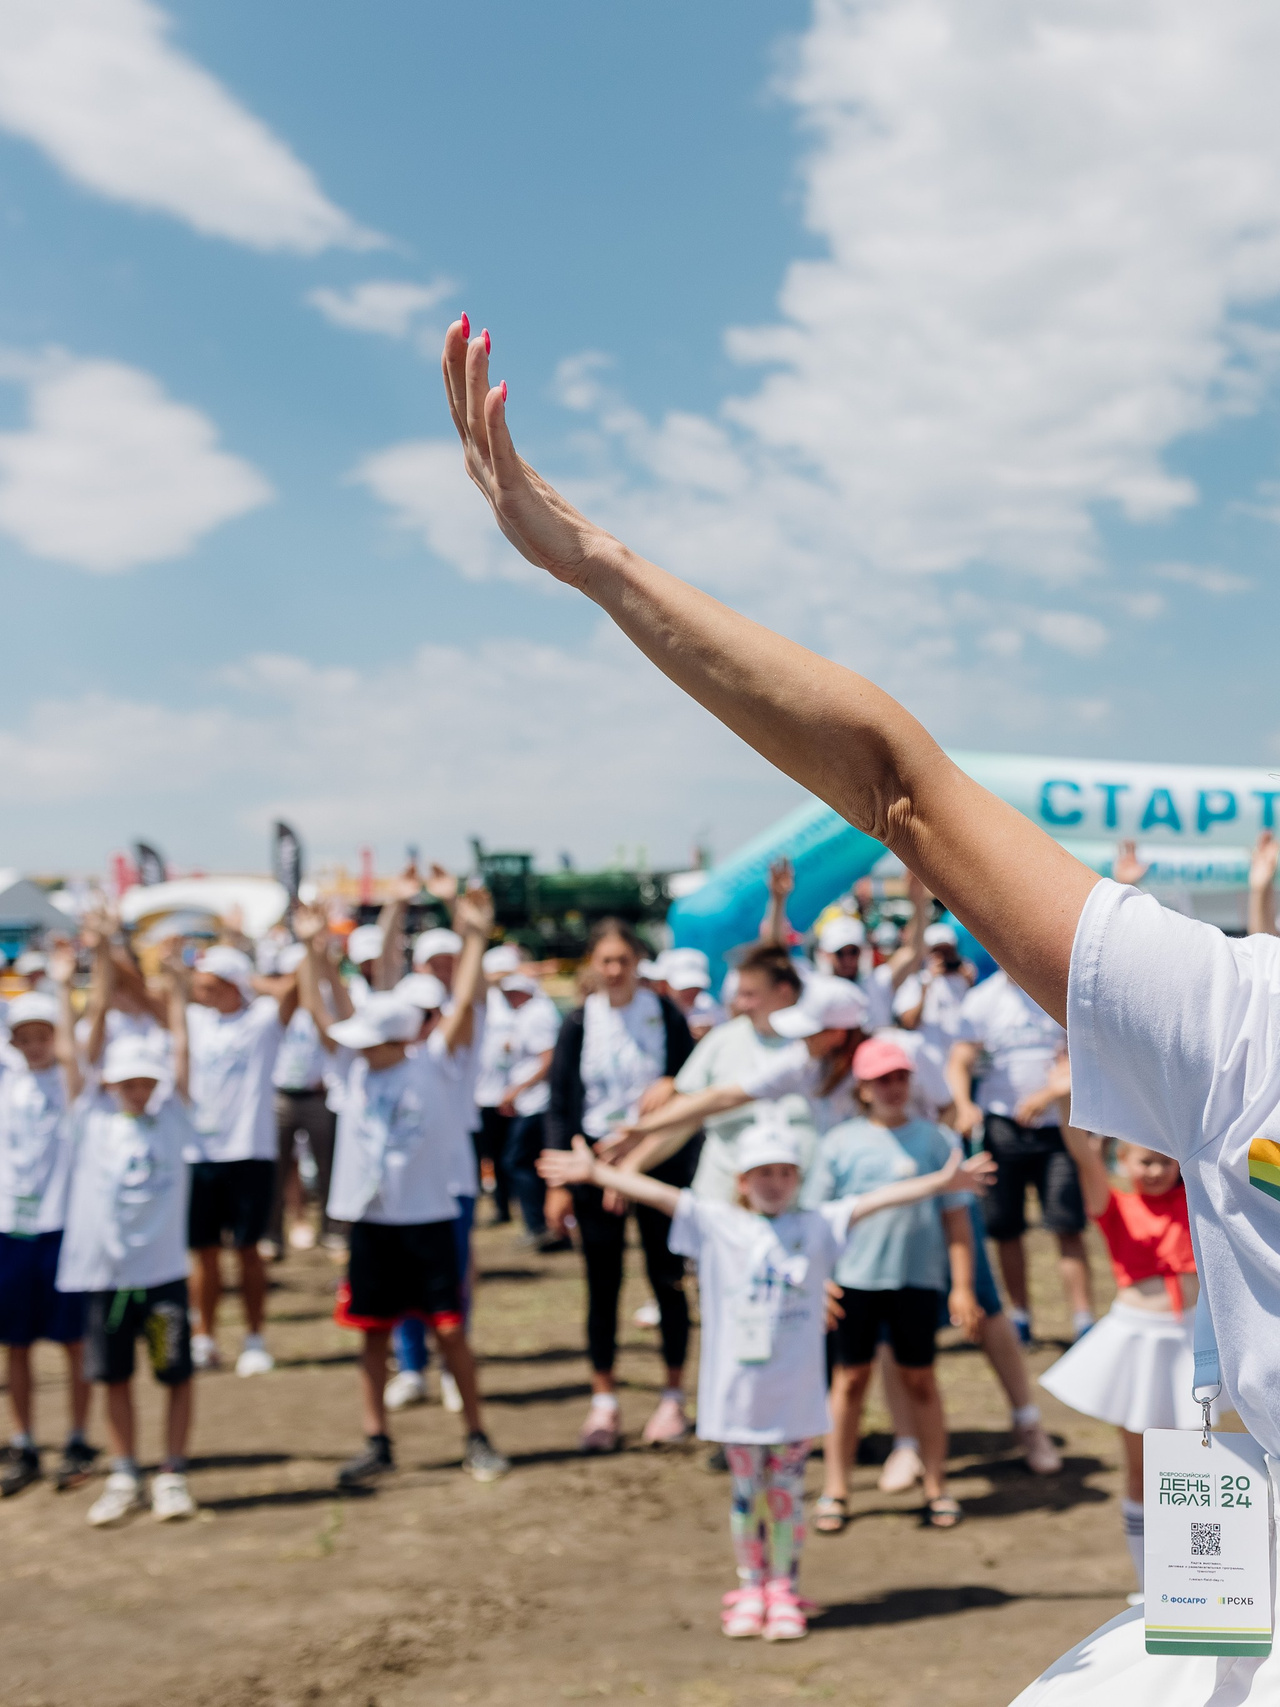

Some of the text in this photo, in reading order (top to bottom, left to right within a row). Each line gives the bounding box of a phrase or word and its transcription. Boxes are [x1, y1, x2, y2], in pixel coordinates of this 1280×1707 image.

[1160, 1478, 1210, 1492] ДЕНЬ
[1221, 1475, 1251, 1491] 20
[1159, 1492, 1210, 1507] ПОЛЯ
[1221, 1492, 1252, 1508] 24
[1170, 1596, 1206, 1605] ФОСАГРО
[1227, 1597, 1254, 1605] РСХБ
